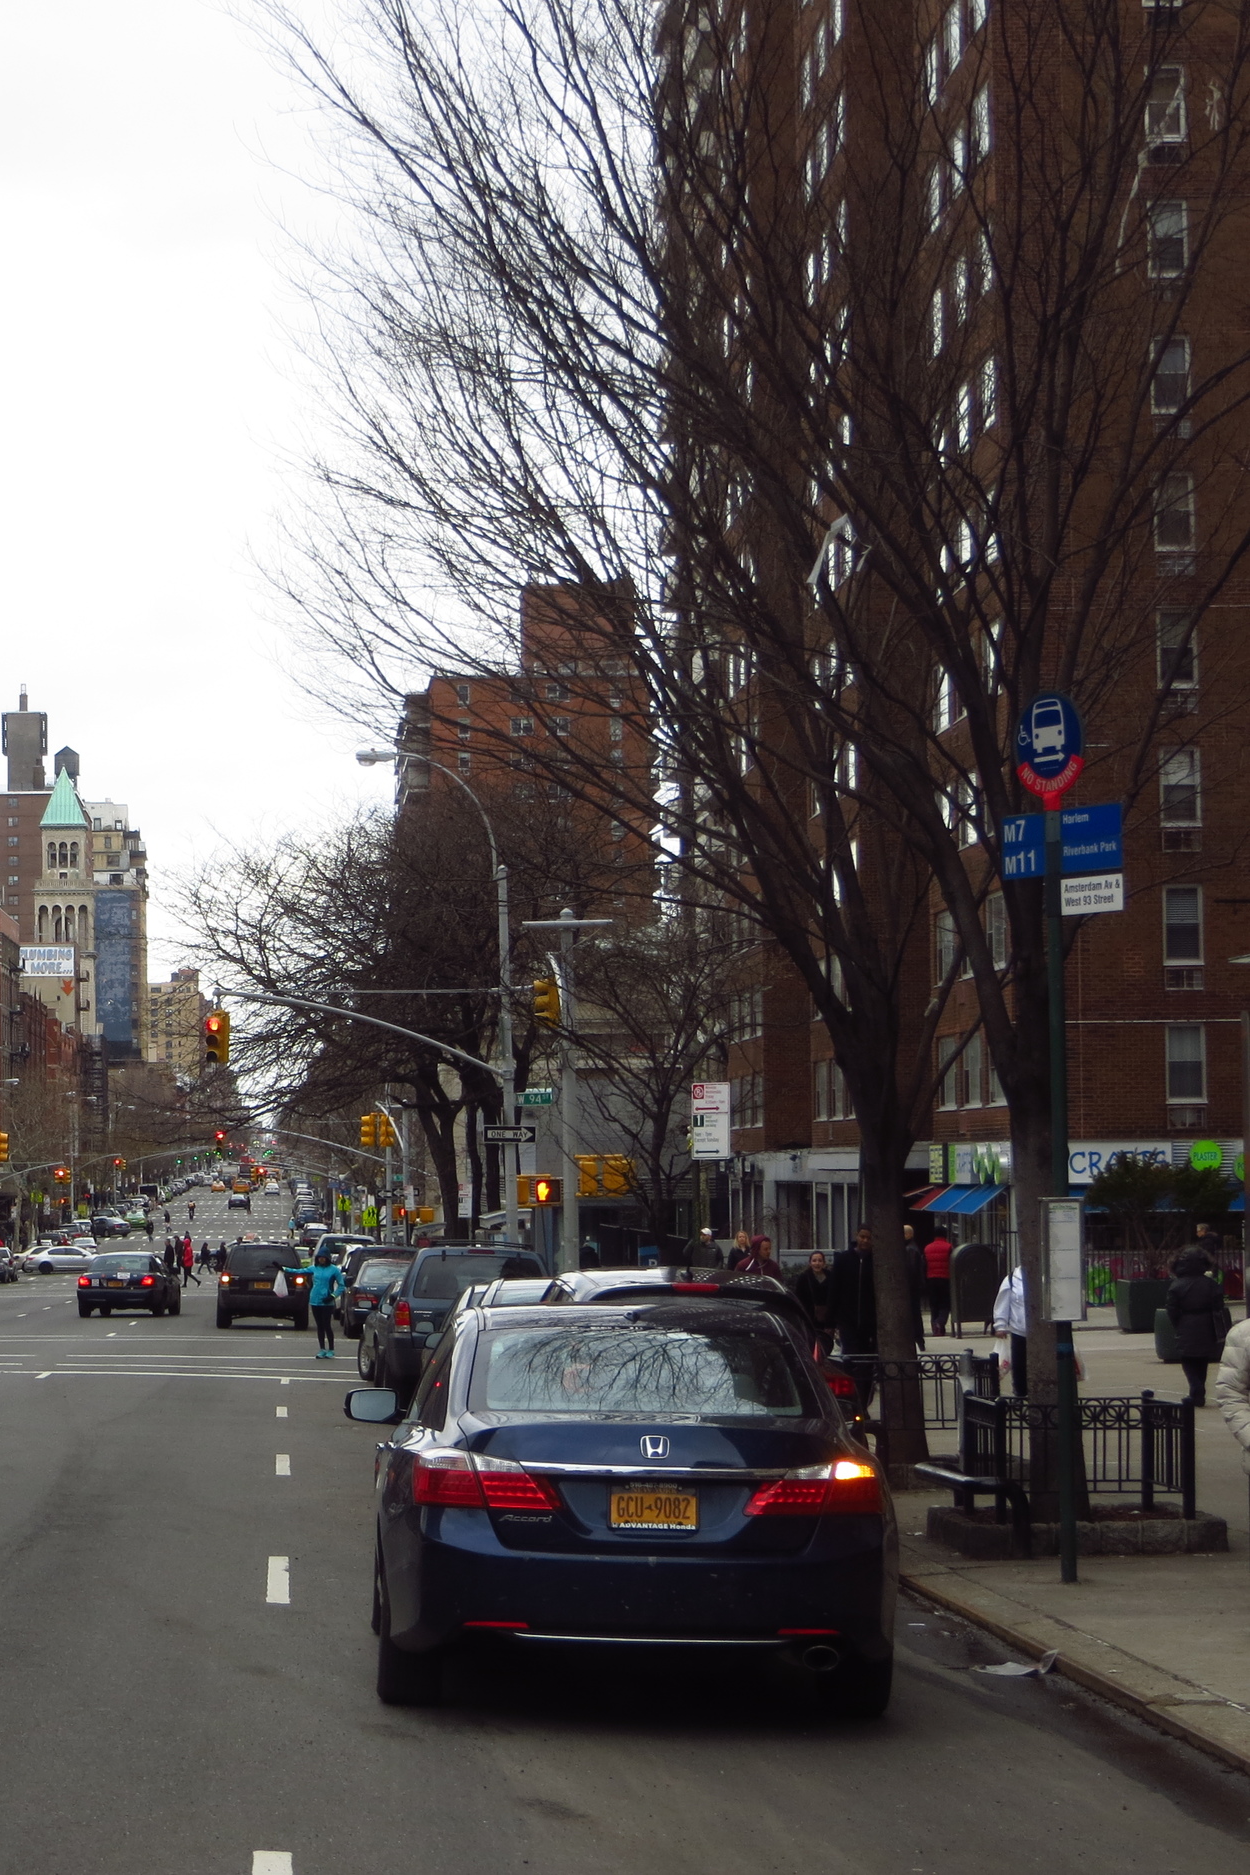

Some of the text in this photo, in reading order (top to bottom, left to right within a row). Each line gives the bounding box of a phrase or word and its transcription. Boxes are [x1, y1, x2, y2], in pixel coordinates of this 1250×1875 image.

[1021, 761, 1078, 792] NO STANDING
[1062, 813, 1090, 825] Harlem
[1003, 819, 1026, 844] M7
[1063, 841, 1117, 857] Riverbank Park
[1004, 850, 1036, 875] M11
[1064, 879, 1121, 894] Amsterdam Av &
[1065, 893, 1114, 907] West 93 Street
[517, 1094, 525, 1105] W
[528, 1094, 542, 1105] 94
[491, 1130, 528, 1139] ONE WAY
[1193, 1151, 1218, 1161] PLASTER
[1070, 1150, 1168, 1178] CRATS
[617, 1496, 691, 1519] GCU 9082
[498, 1514, 553, 1523] Accord
[619, 1522, 668, 1530] ADVANTAGE
